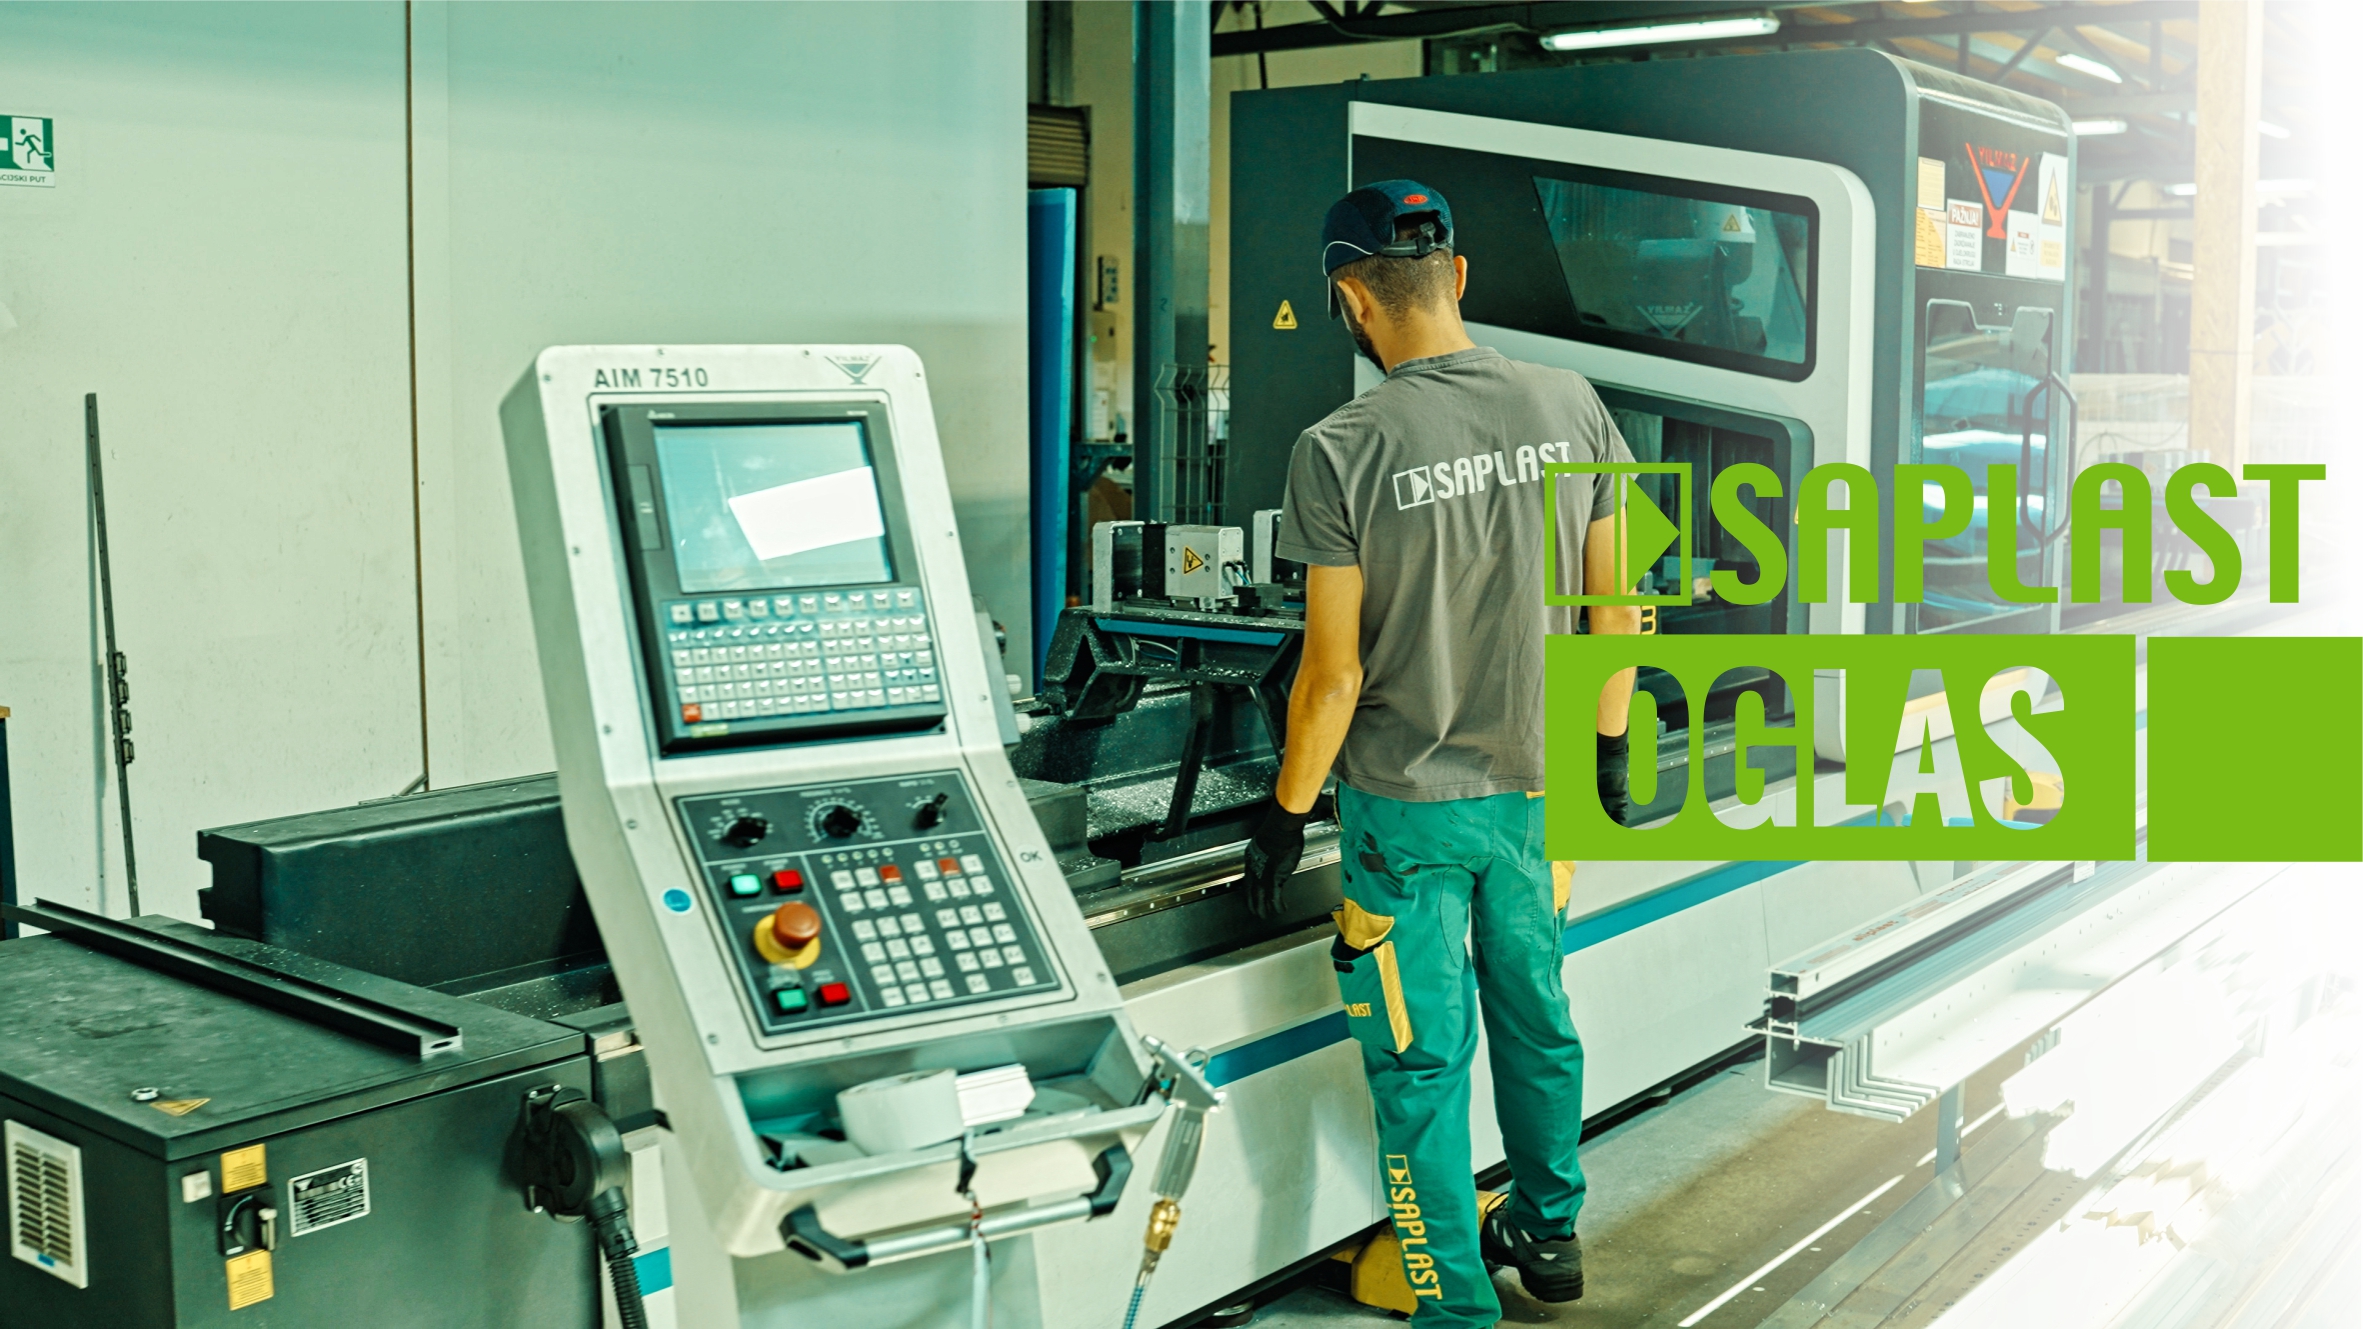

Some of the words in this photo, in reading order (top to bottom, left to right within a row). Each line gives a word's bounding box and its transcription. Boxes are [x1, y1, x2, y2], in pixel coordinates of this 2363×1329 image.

[1647, 304, 1690, 315] YILMAZ
[594, 368, 642, 388] AIM
[649, 367, 709, 388] 7510
[1433, 441, 1571, 500] SAPLAST
[1020, 850, 1043, 863] OK
[1390, 1186, 1443, 1301] SAPLAST
